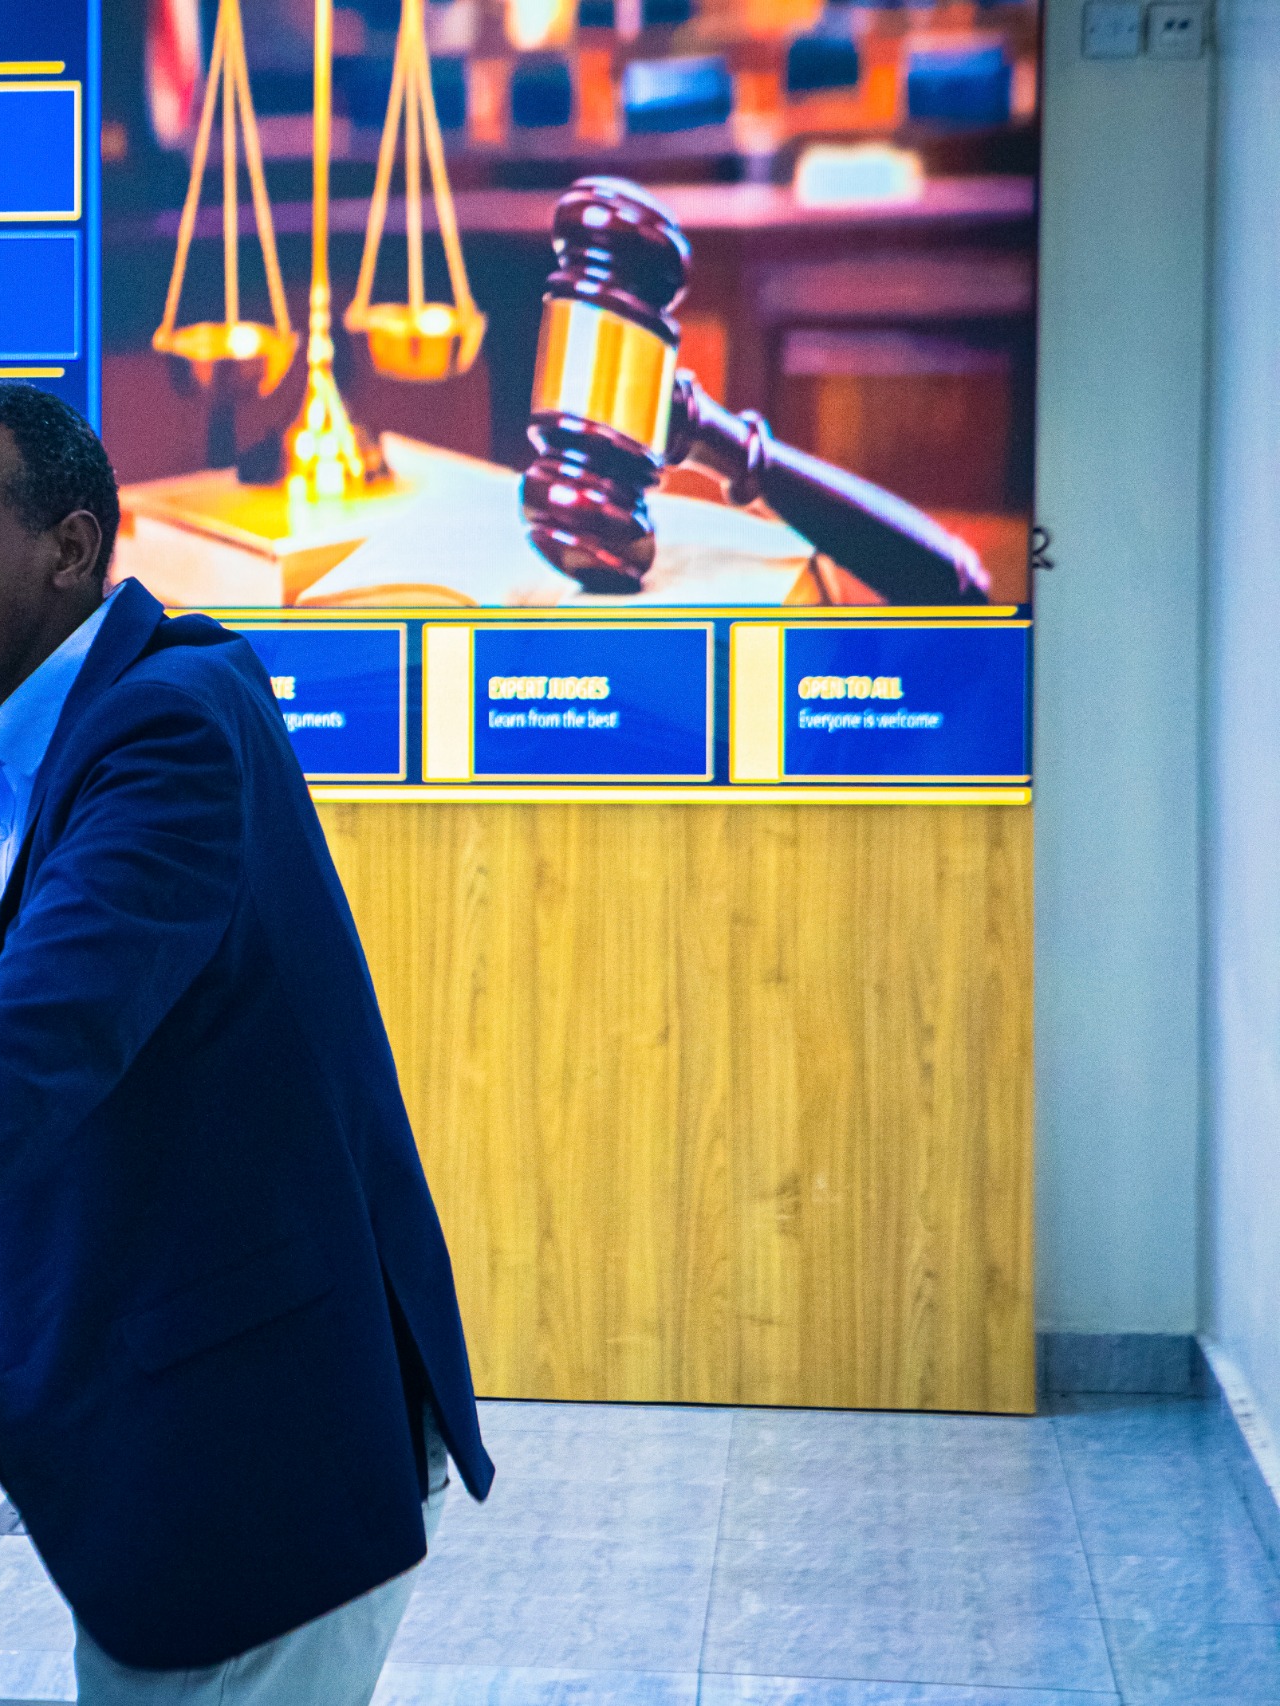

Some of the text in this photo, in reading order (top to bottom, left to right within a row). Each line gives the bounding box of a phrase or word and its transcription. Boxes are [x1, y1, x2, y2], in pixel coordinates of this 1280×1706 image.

[488, 676, 609, 699] EXPERT JUDGES
[798, 676, 903, 699] OPEN TO ALL
[489, 708, 617, 728] Learn from the best
[799, 709, 941, 732] Everyone is welcome
